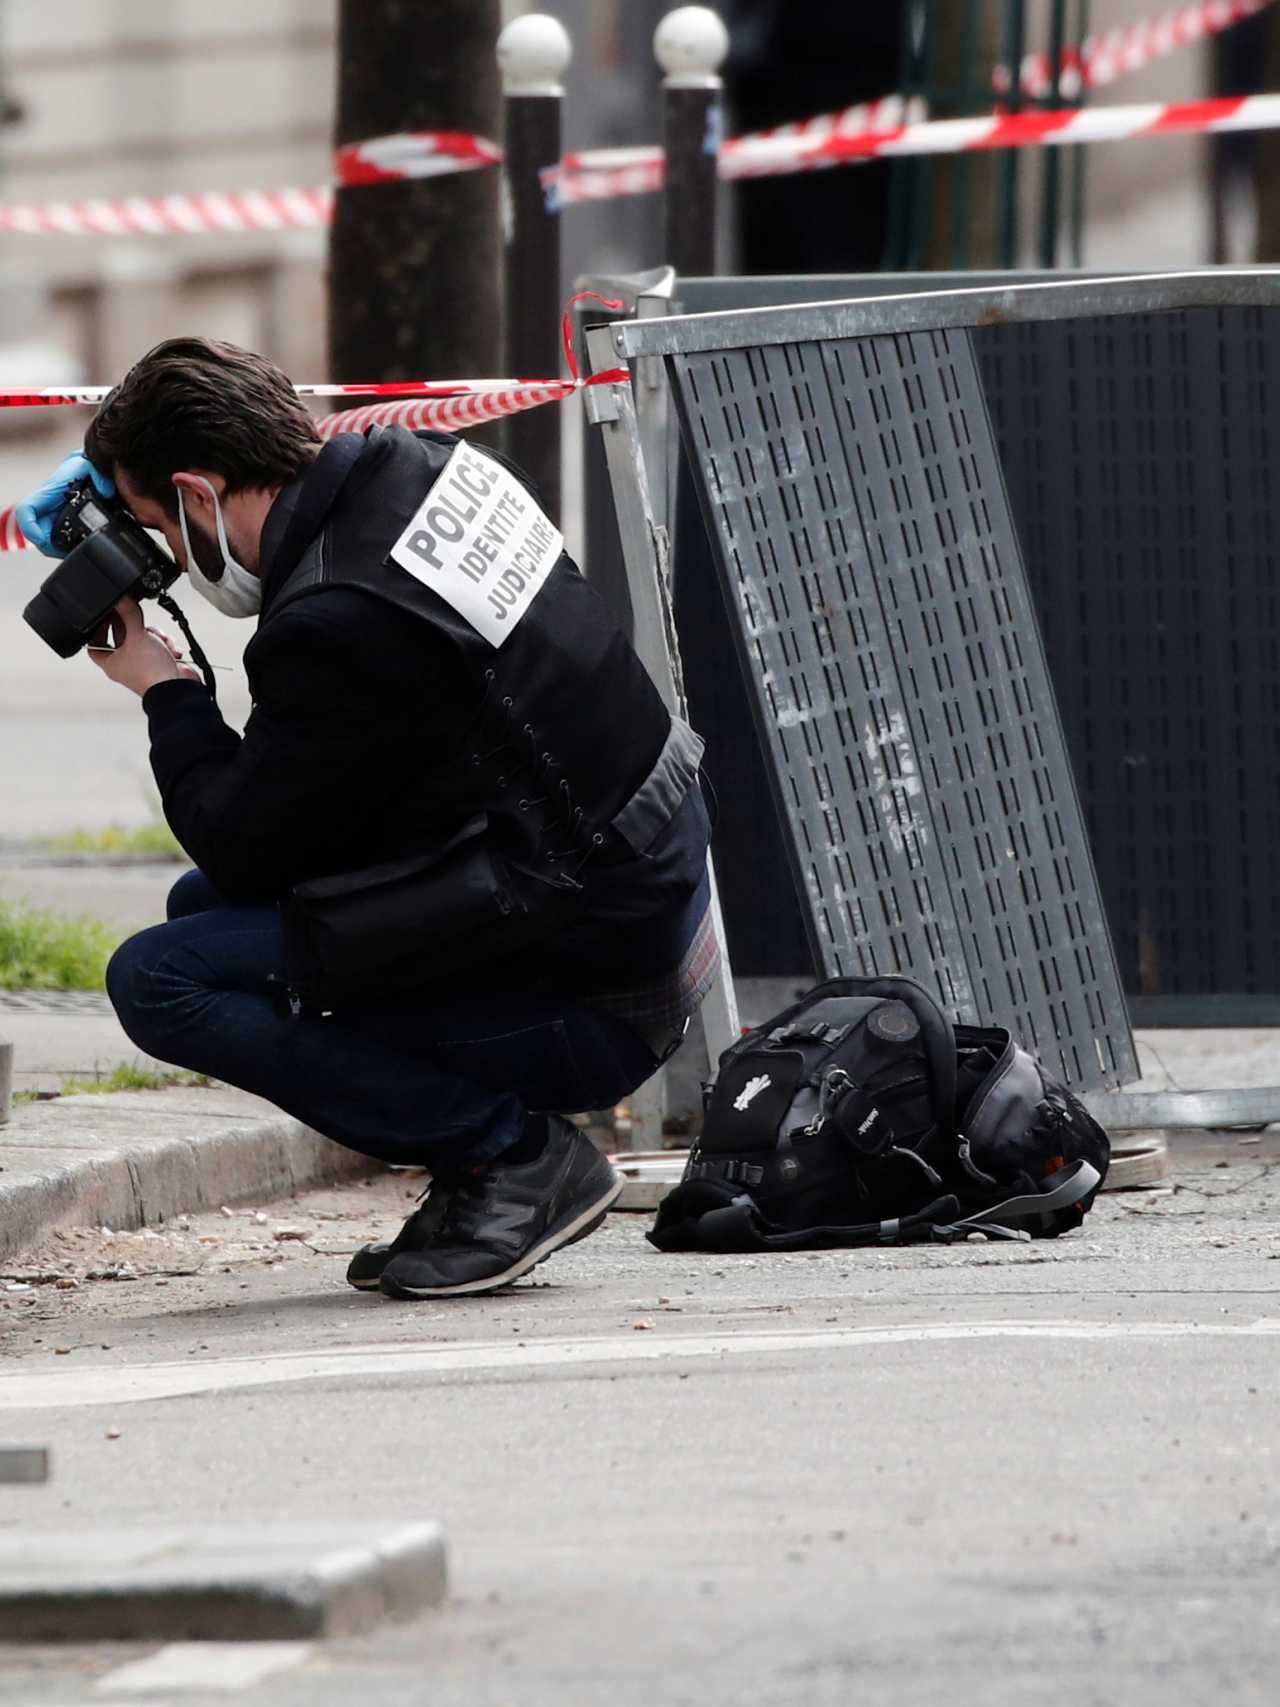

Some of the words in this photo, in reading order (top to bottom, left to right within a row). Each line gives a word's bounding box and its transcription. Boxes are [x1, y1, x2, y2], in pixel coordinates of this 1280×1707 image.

[405, 453, 500, 571] POLICE
[457, 489, 526, 584] IDENTITE
[487, 516, 554, 620] JUDICIAIRE
